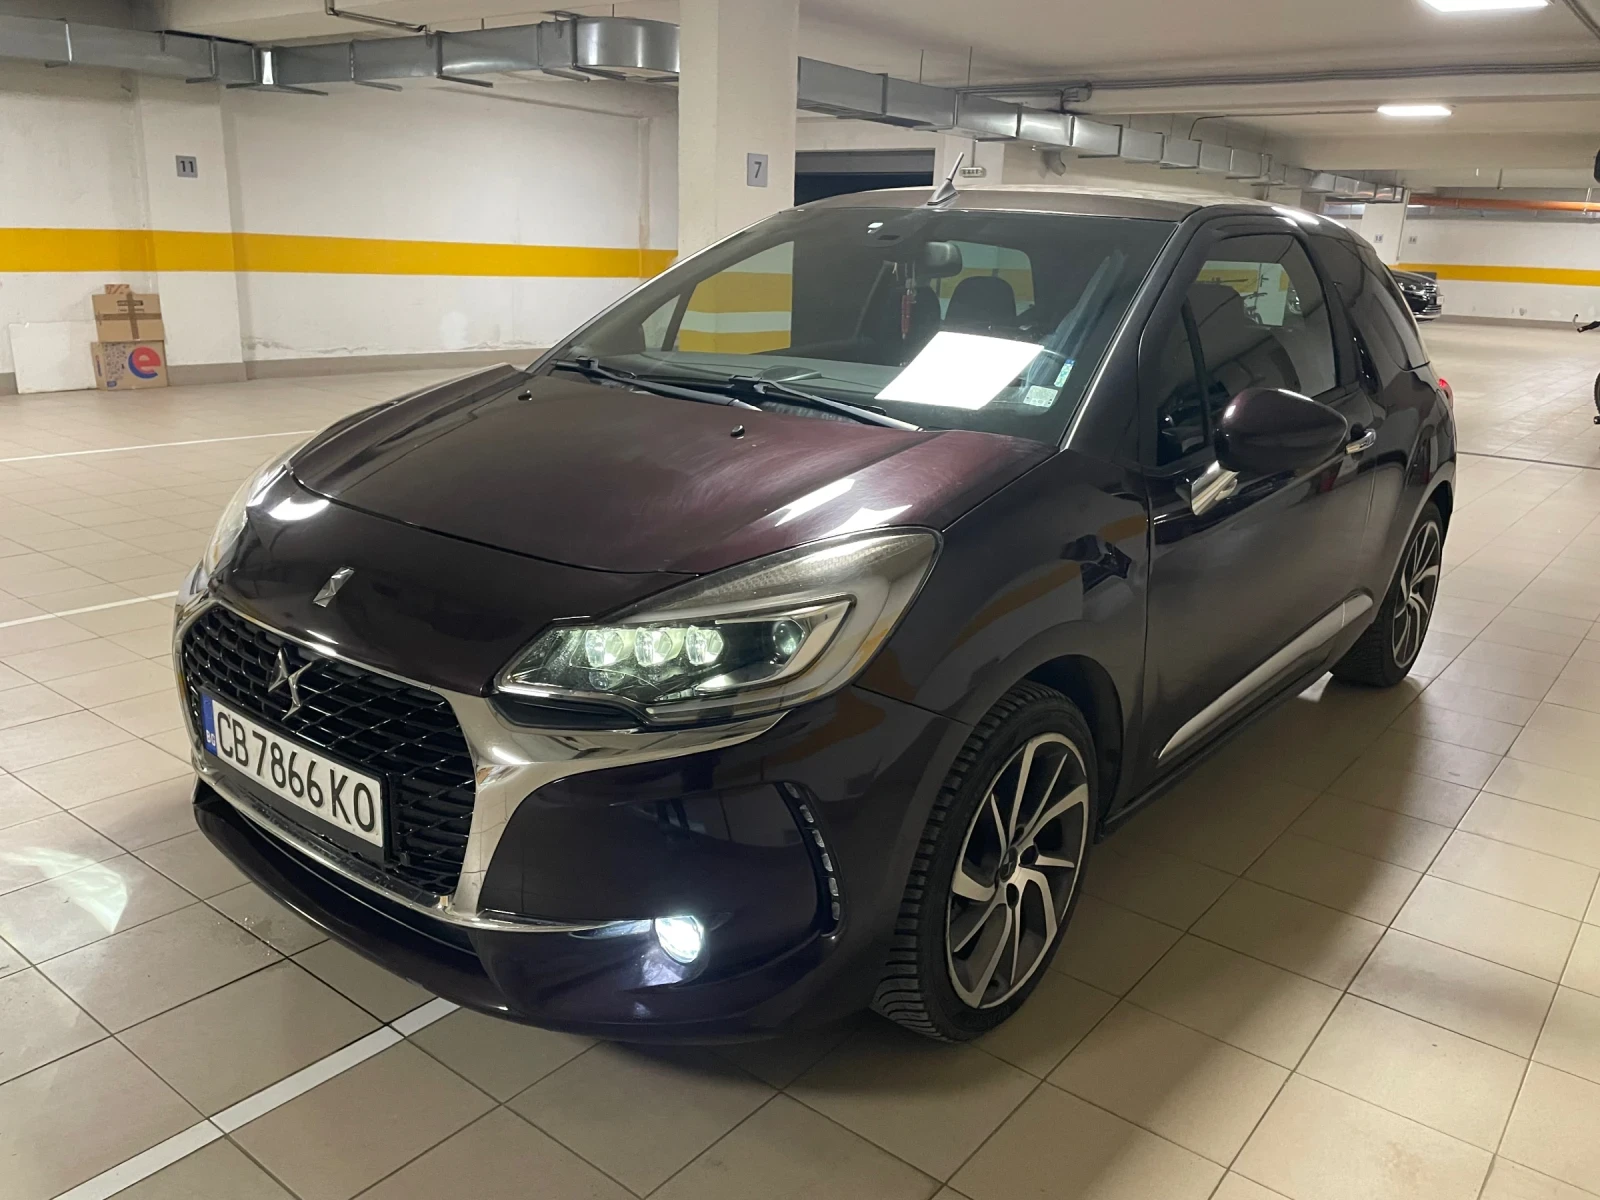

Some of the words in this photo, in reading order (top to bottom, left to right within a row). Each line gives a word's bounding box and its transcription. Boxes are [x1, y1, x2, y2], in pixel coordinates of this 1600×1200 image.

[180, 160, 194, 173] 11
[754, 161, 762, 179] 7
[205, 729, 217, 747] BG
[217, 710, 249, 767] CB
[252, 730, 324, 808] 7866
